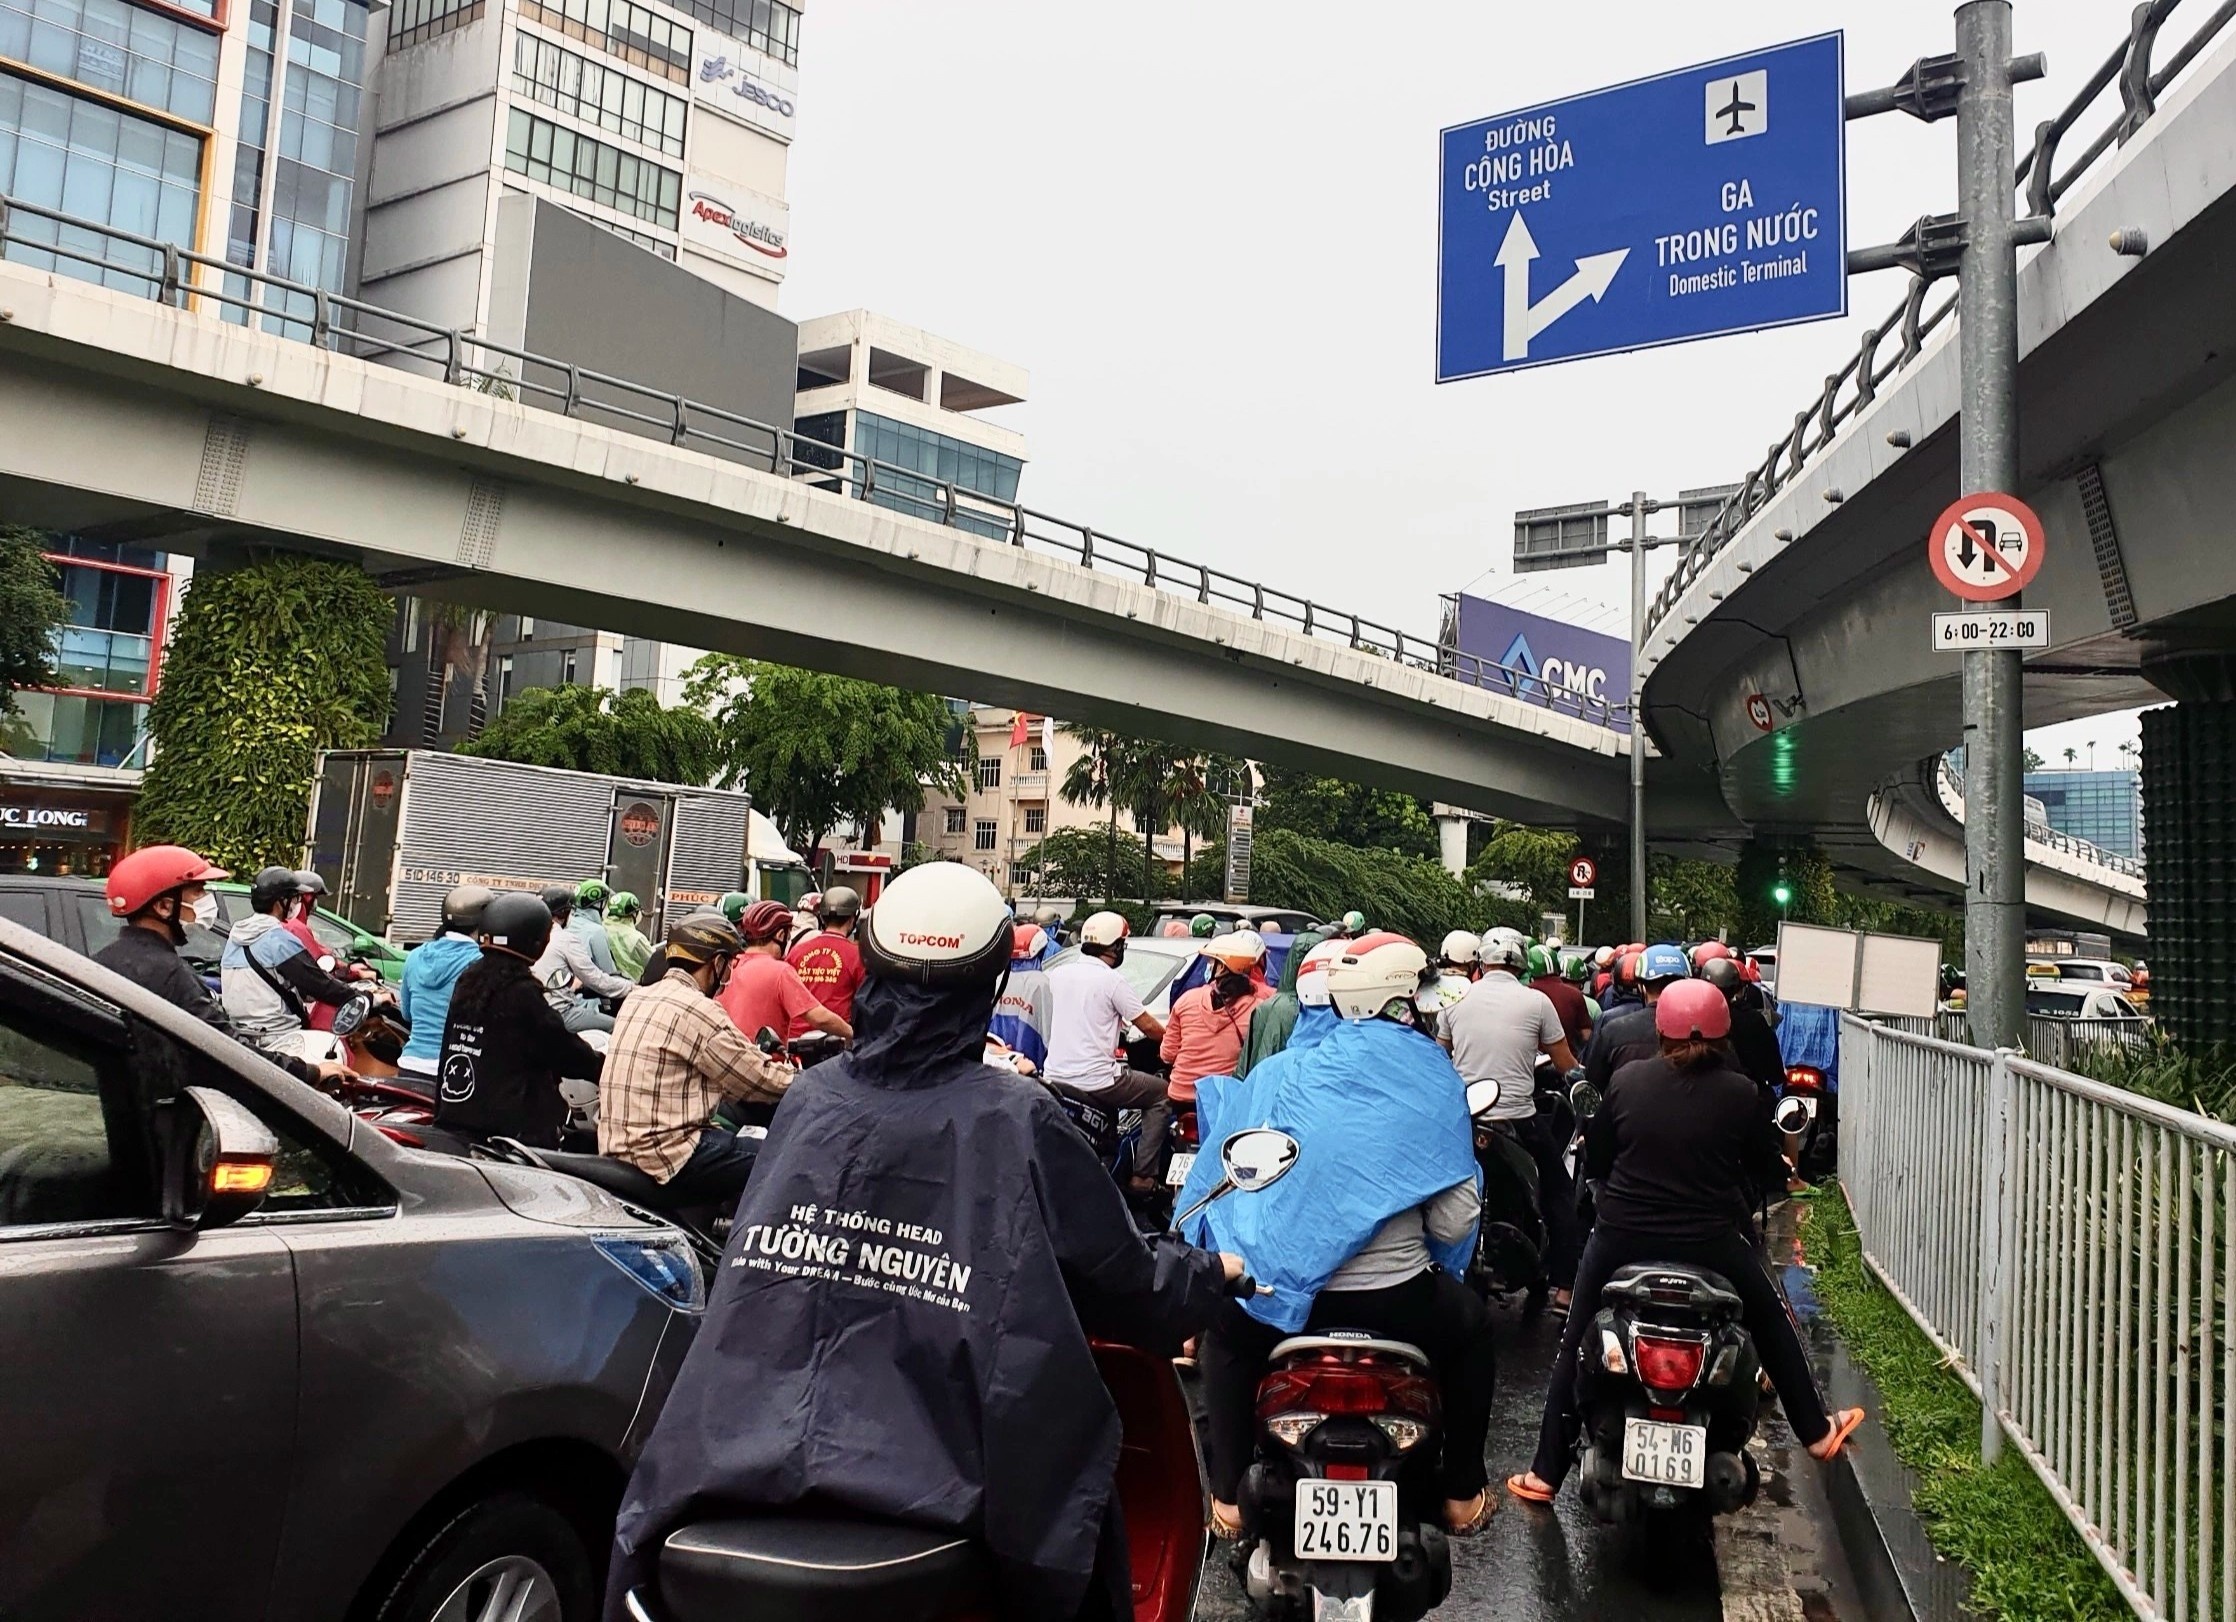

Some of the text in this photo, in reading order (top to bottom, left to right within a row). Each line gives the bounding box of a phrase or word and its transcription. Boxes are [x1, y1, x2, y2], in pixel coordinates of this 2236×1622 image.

[1485, 115, 1556, 152] ĐƯỜNG
[1464, 137, 1574, 192] CỘNG HÒA
[1488, 179, 1551, 211] Street
[1721, 178, 1754, 212] GA
[1654, 201, 1818, 267] TRONG NƯỚC
[1669, 249, 1808, 297] Domestic Terminal
[1541, 657, 1607, 707] CMC
[26, 809, 82, 826] LONG
[671, 891, 709, 903] PHÚC
[790, 1203, 943, 1246] HỆ THỐNG HEAD
[743, 1223, 972, 1294] TƯỜNG NGUYÊN
[748, 1257, 772, 1270] with
[775, 1261, 799, 1275] Your
[1328, 1331, 1373, 1340] HONDA
[1636, 1425, 1693, 1455] 54-M6
[1634, 1452, 1692, 1482] 0169
[1312, 1486, 1378, 1519] 59-Y1
[1302, 1521, 1390, 1554] 246.76
